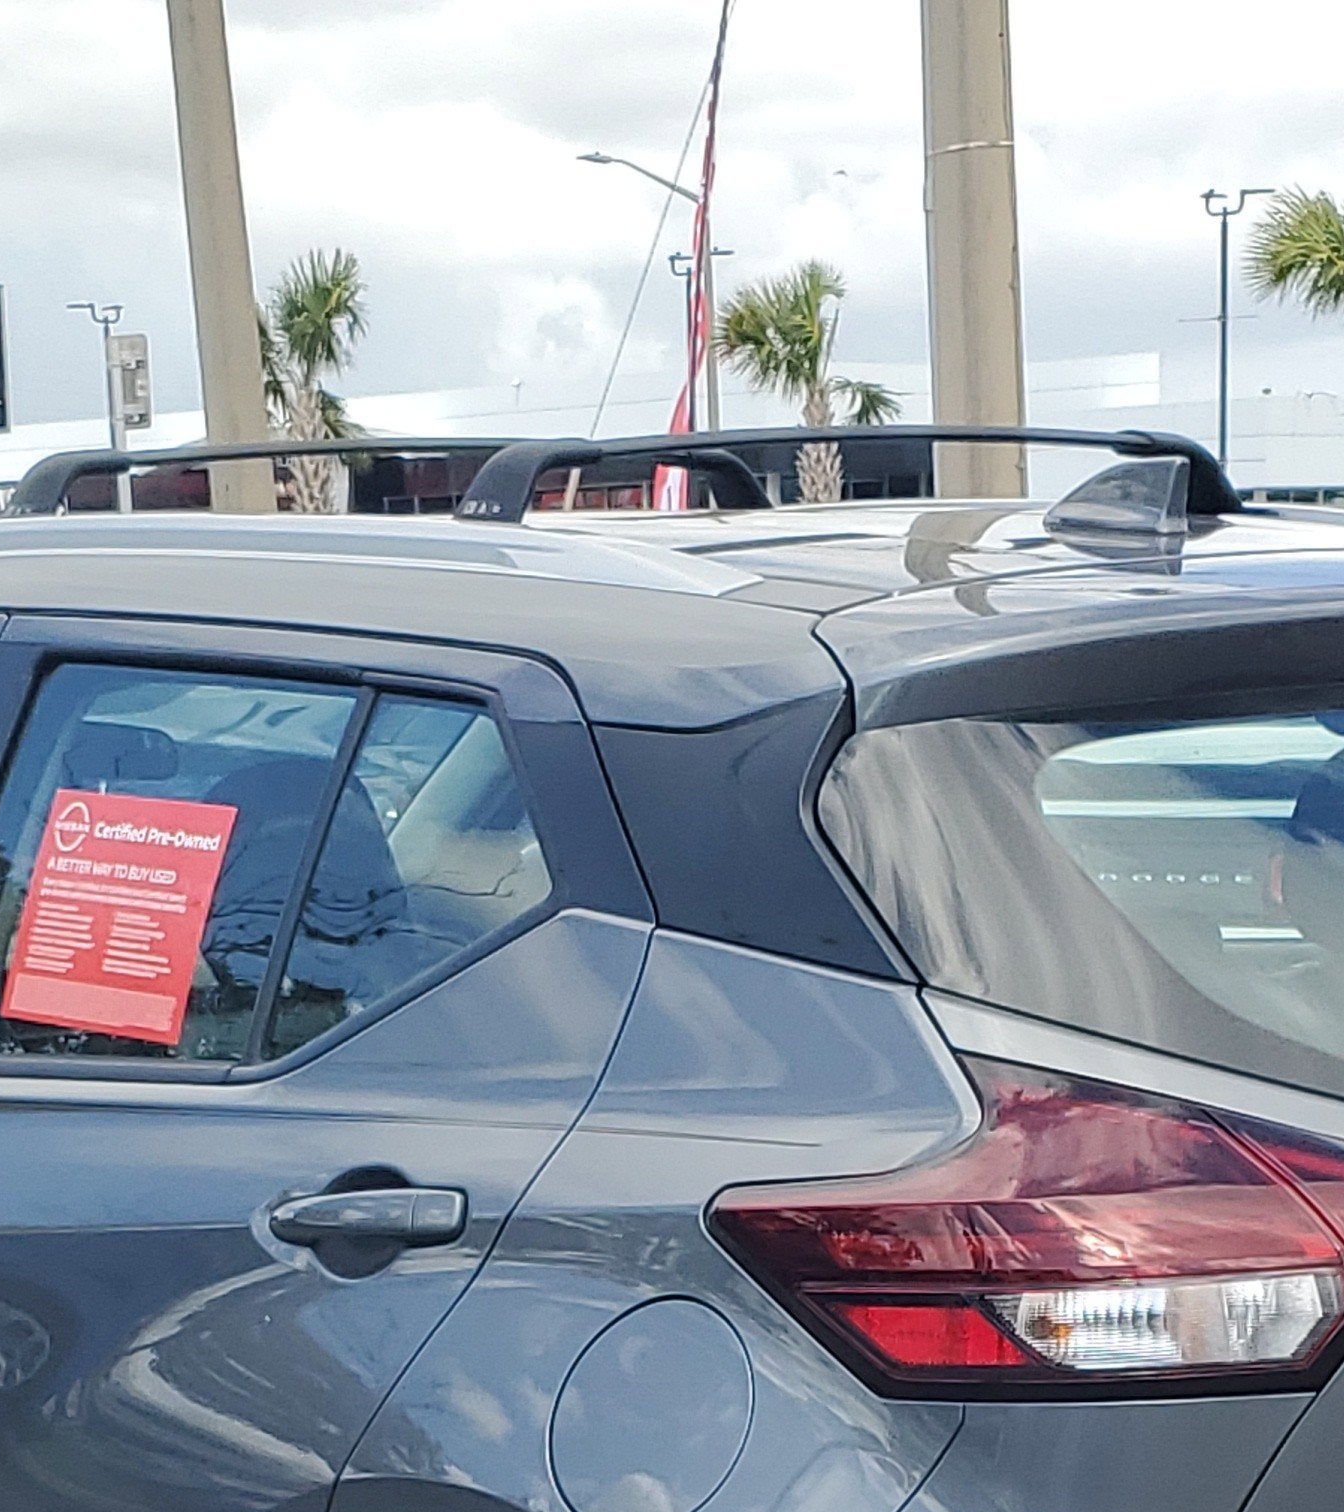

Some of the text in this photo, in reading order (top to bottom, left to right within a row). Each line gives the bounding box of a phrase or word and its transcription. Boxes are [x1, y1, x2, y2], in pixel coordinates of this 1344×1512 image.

[94, 820, 222, 851] Certified Pre-Owned
[47, 857, 56, 870] A
[56, 858, 93, 875] BETTER
[93, 861, 114, 877] WAY
[113, 863, 128, 879] TO
[128, 865, 151, 882] BUY
